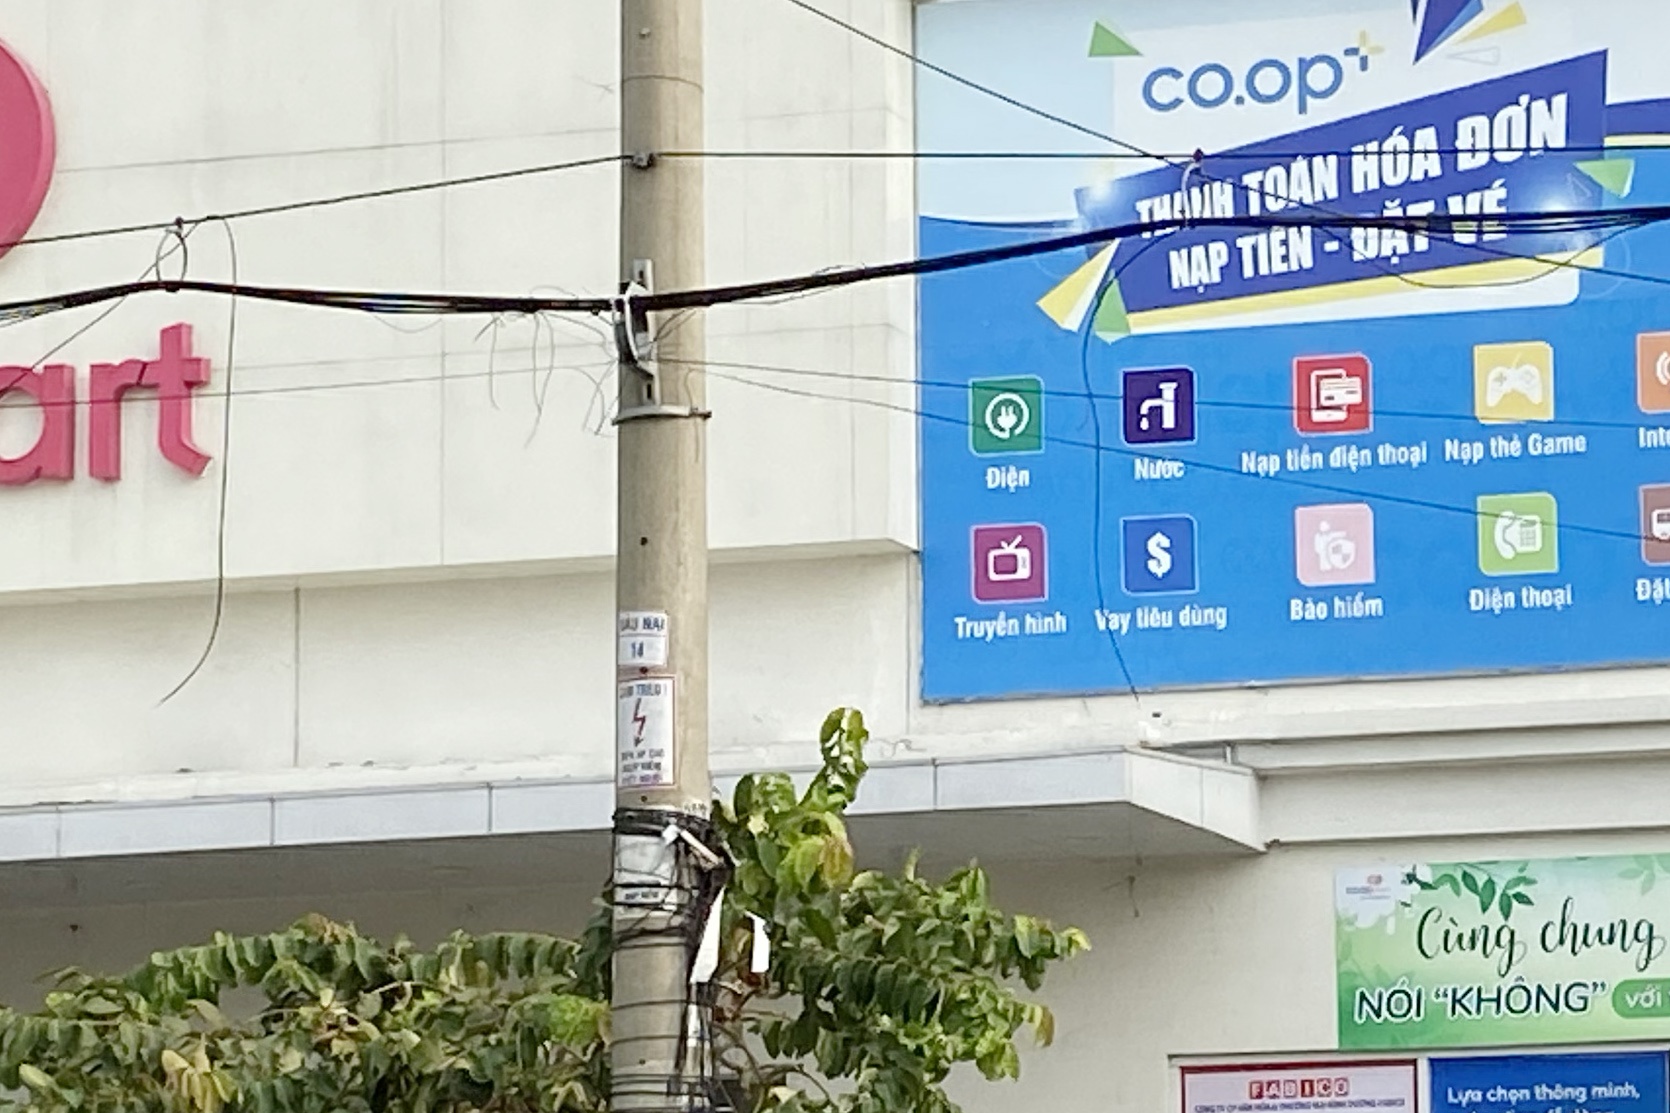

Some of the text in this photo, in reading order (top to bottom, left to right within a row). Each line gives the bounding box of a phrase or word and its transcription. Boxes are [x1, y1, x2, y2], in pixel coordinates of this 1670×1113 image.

[1135, 93, 1568, 238] THANH TOÁN HÓA ĐƠN
[1169, 240, 1229, 294] NẠP
[1447, 177, 1508, 243] VÉ
[1240, 441, 1428, 477] Nạp tiền điện thoại
[1444, 432, 1588, 466] Nạp thẻ Game
[985, 464, 1031, 493] Điện
[1134, 456, 1185, 481] Nước
[1290, 592, 1384, 622] Bảo hiểm
[1468, 584, 1573, 615] Điện thoại
[1635, 577, 1670, 606] Đặt
[954, 610, 1068, 643] Truyền hình
[1095, 603, 1228, 636] Vay tiêu dùng
[1416, 904, 1528, 978] Cùng
[1540, 896, 1667, 973] chung
[1354, 976, 1424, 1023] NÓI
[1625, 983, 1663, 1009] với
[1447, 1080, 1641, 1108] Lựa chọn thông minh,
